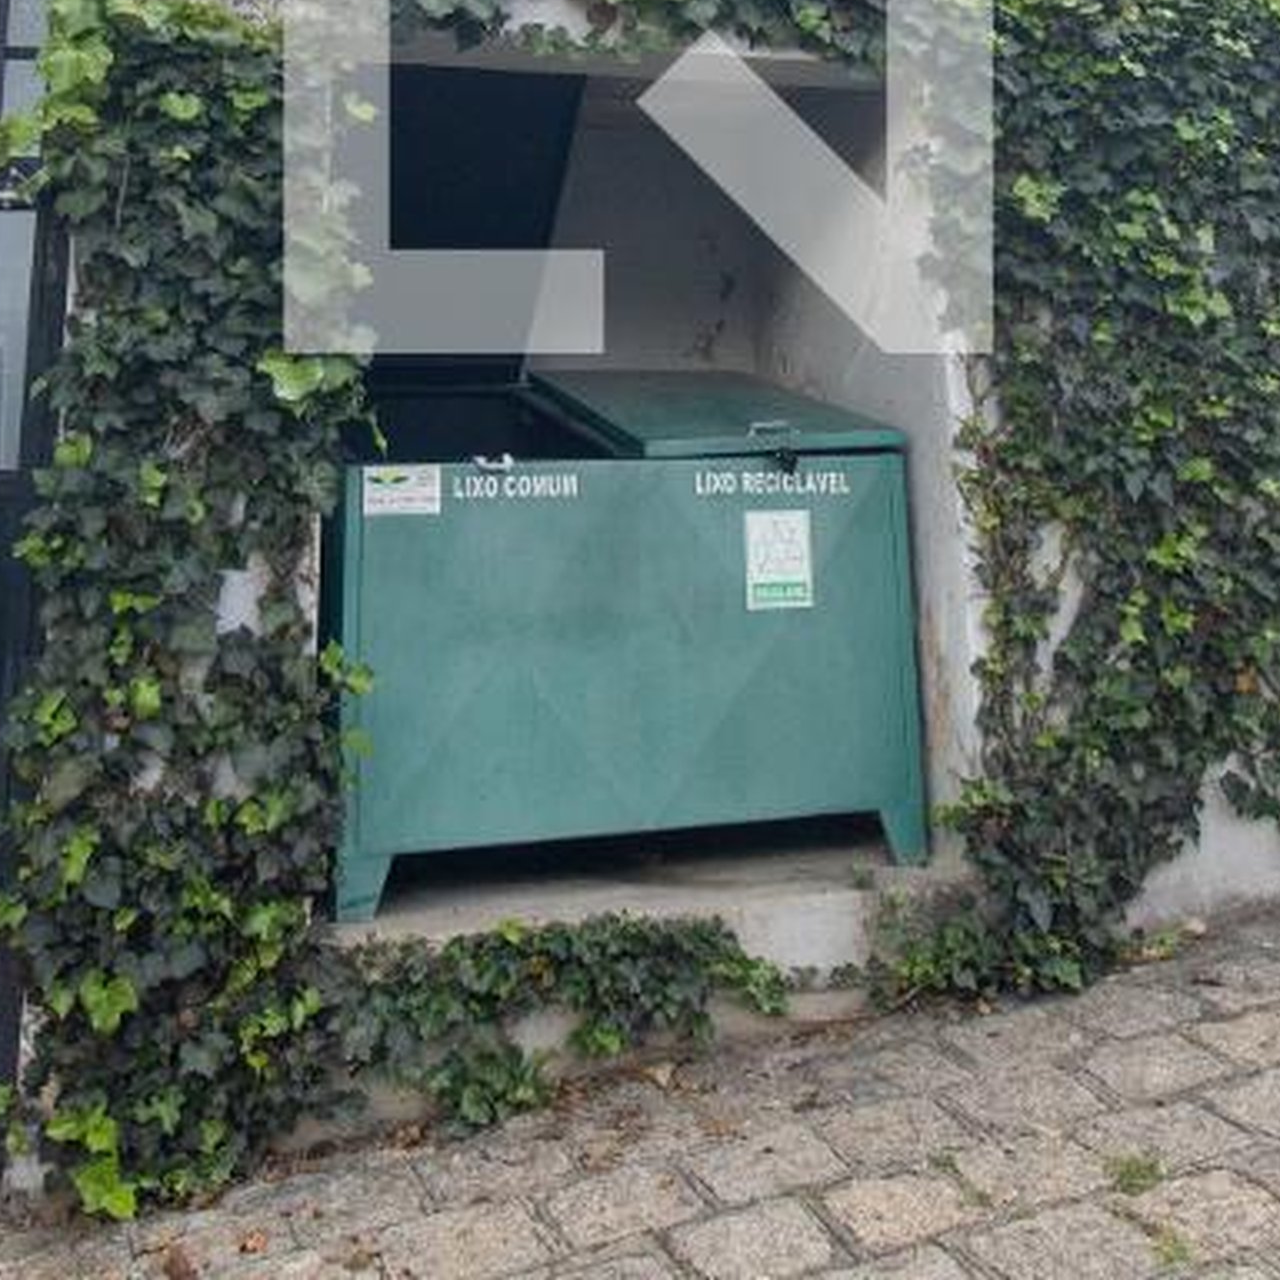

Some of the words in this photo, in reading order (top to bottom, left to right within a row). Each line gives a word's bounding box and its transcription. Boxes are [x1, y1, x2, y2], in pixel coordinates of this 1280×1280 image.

[452, 475, 499, 498] LIXO
[503, 473, 579, 498] COMUM
[694, 471, 738, 495] LIXO
